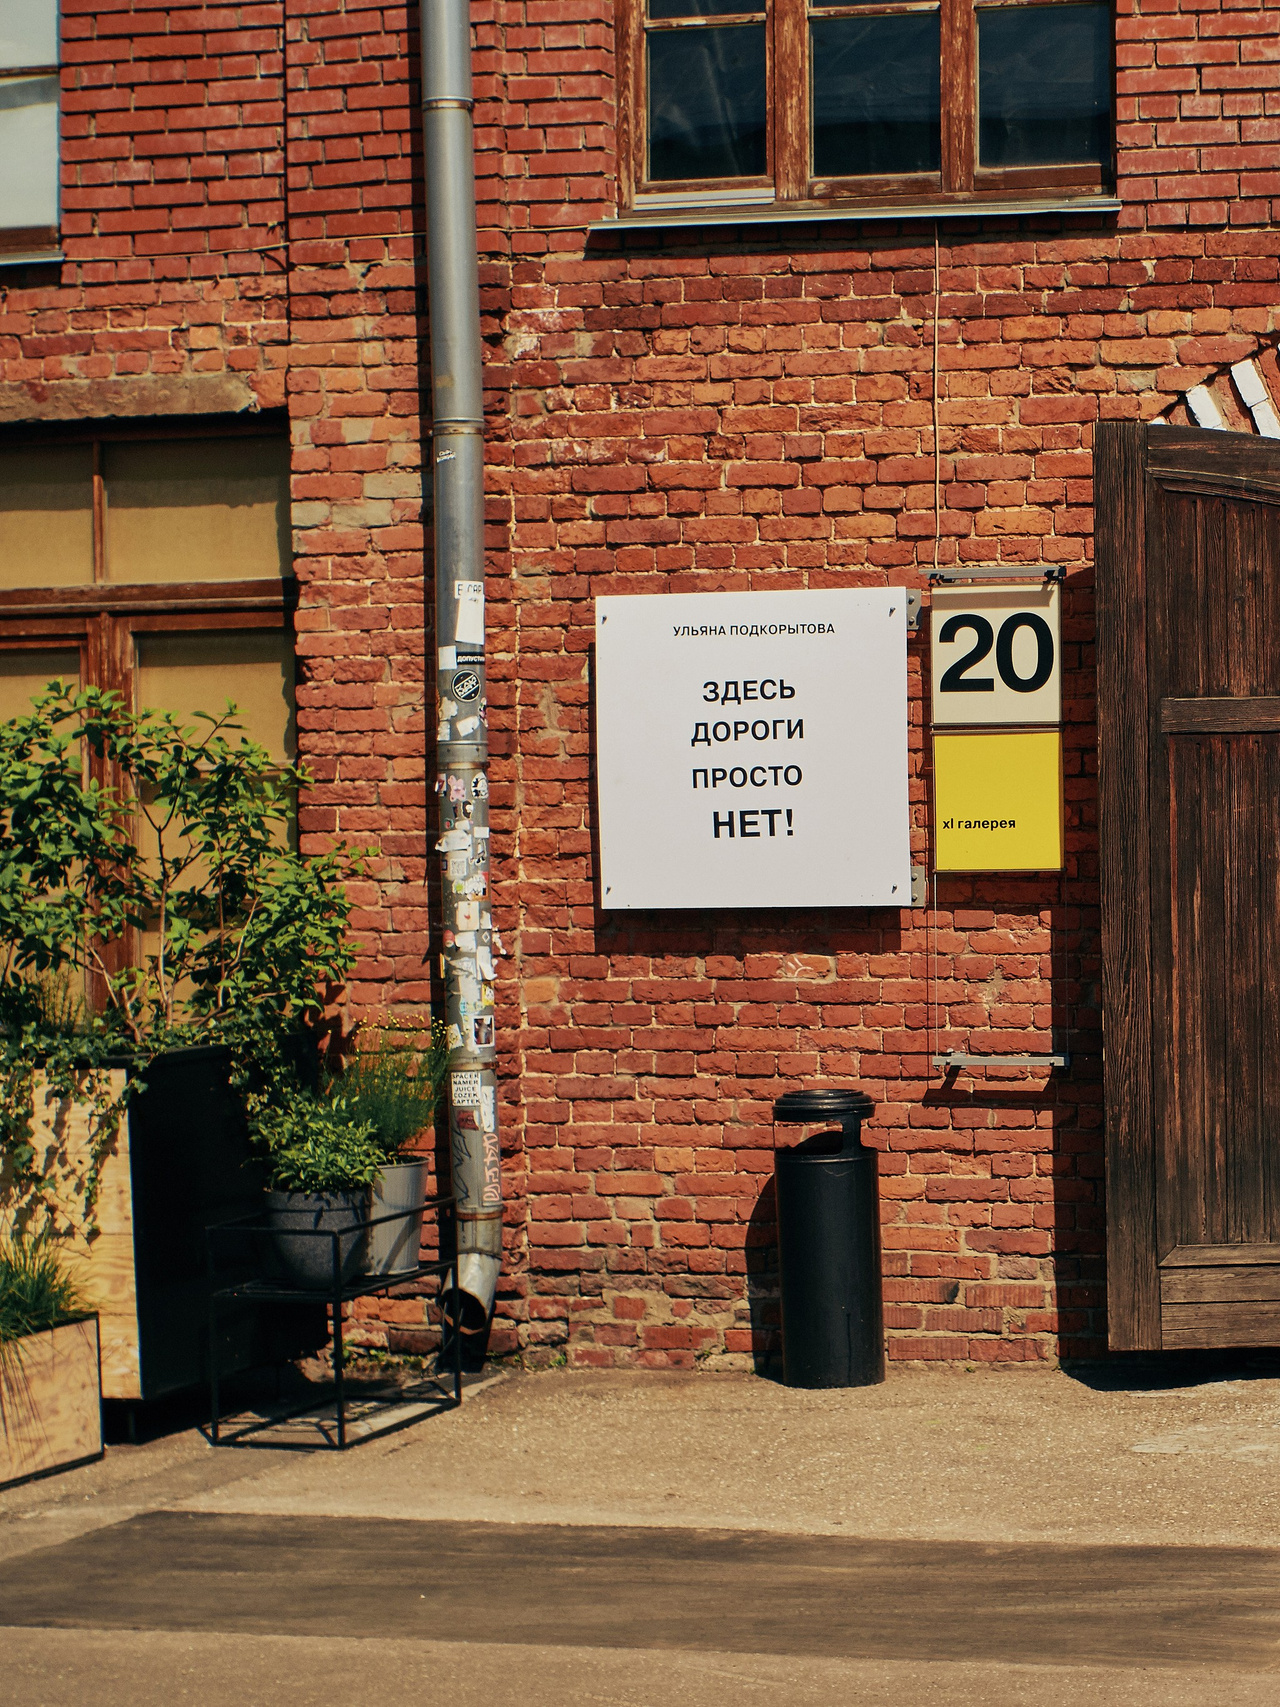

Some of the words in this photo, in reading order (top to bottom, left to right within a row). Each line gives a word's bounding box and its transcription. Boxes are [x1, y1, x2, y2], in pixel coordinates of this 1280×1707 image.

[673, 625, 727, 637] УЛЬЯНА
[730, 623, 836, 637] ПОДКОРЫТОВА
[938, 611, 1055, 694] 20
[702, 678, 796, 706] ЗДЕСЬ
[690, 718, 804, 748] ДОРОГИ
[692, 764, 803, 789] ПРОСТО
[712, 808, 794, 839] НЕТ!
[957, 819, 1016, 832] галерея
